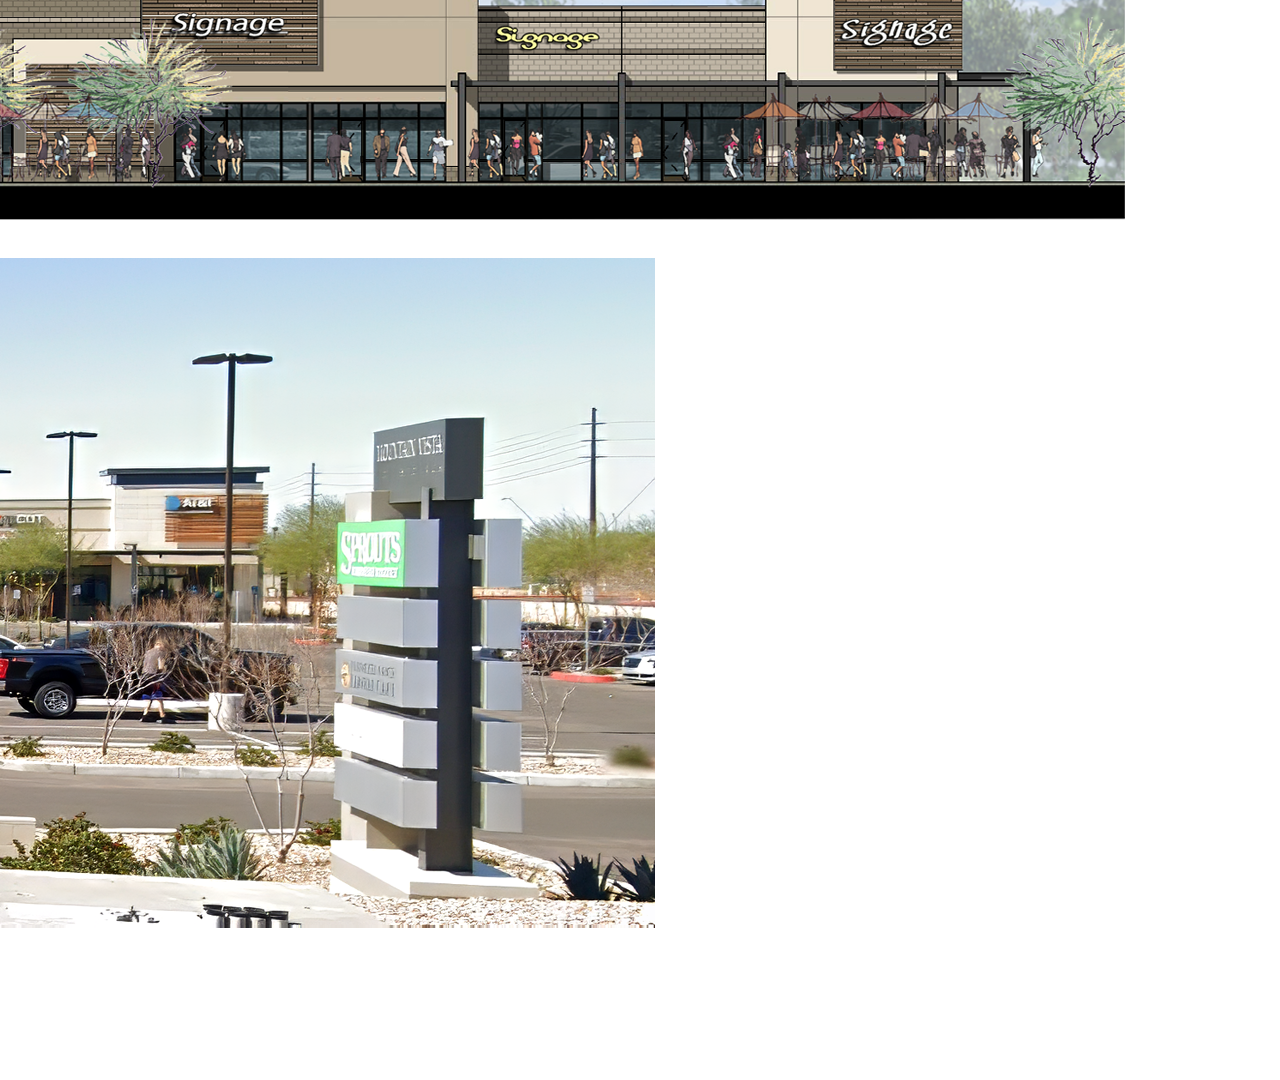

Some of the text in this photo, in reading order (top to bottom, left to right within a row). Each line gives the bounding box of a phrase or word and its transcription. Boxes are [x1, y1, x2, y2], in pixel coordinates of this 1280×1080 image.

[172, 12, 285, 37] Signage
[495, 25, 600, 51] Signage
[841, 18, 953, 47] Signage
[340, 531, 402, 576] SPROUTS
